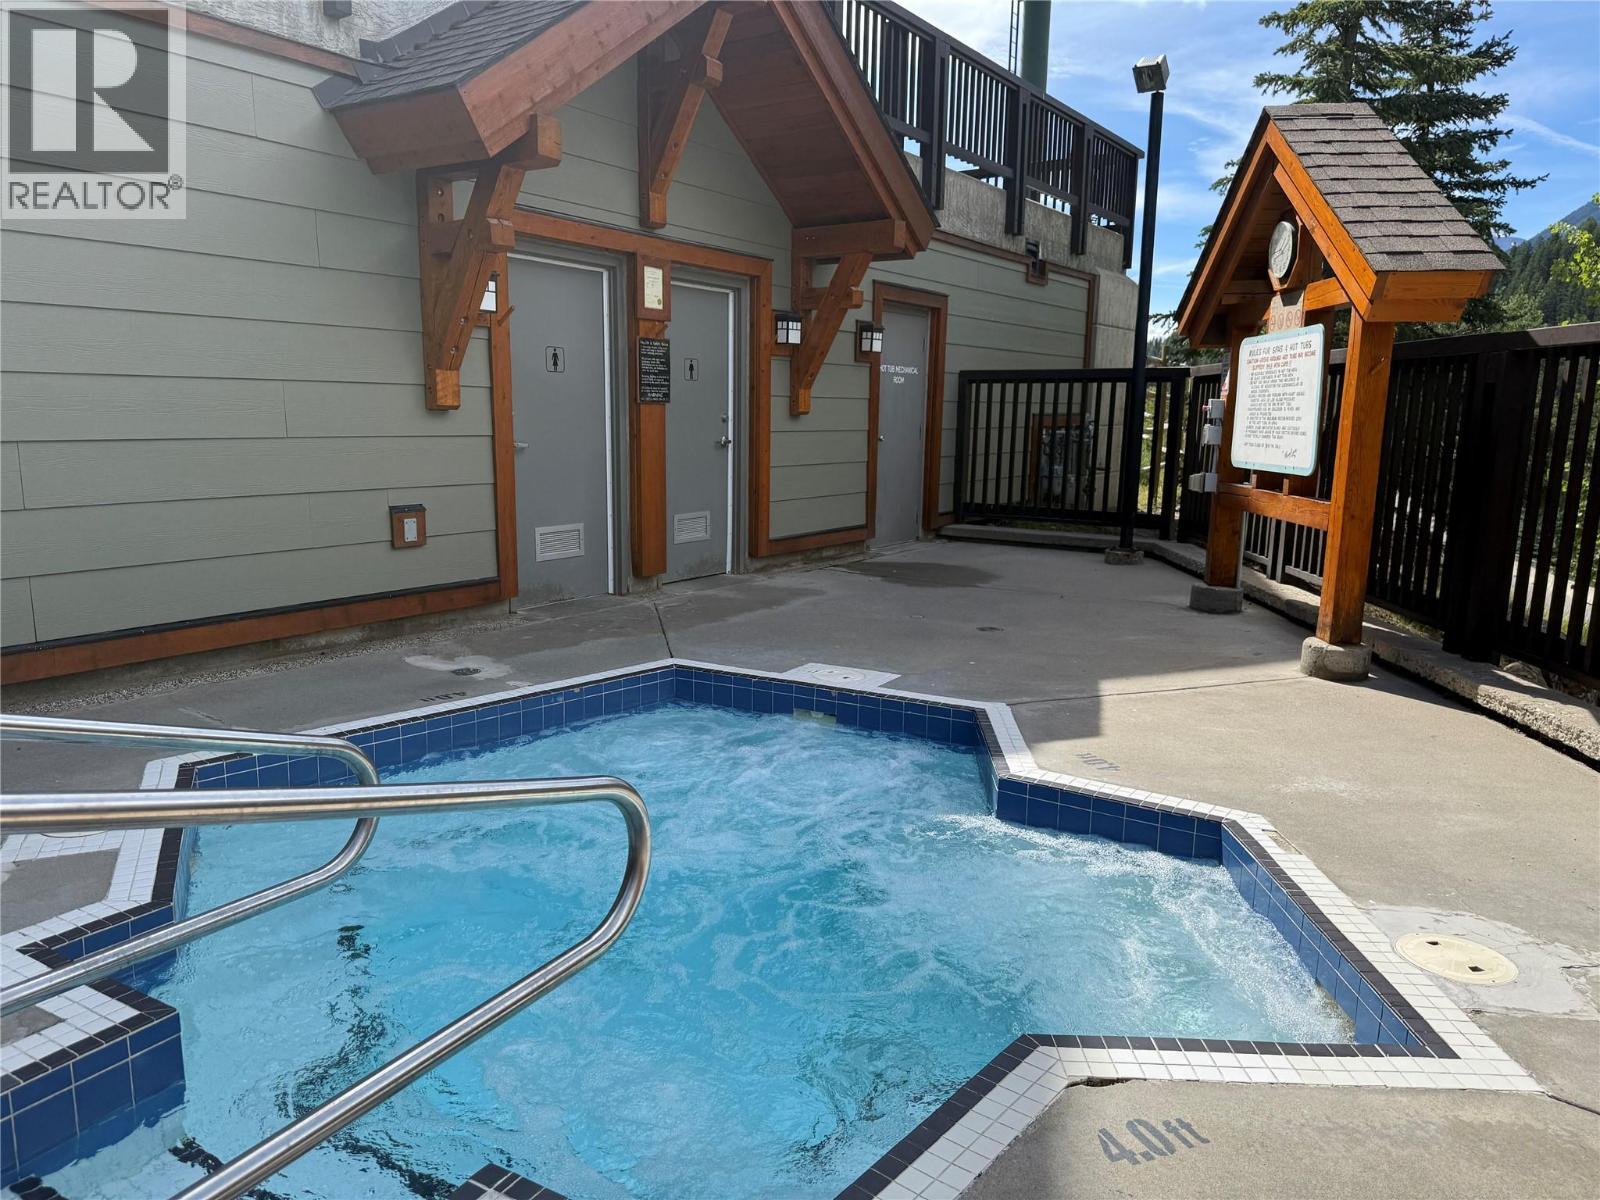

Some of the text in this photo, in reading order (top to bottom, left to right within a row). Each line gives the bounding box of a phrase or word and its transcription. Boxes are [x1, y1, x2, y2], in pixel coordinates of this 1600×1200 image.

[1301, 340, 1312, 349] TUBS
[895, 365, 919, 375] MECHANICAL
[893, 376, 905, 384] ROOM
[1098, 1118, 1210, 1165] 4.0ft
